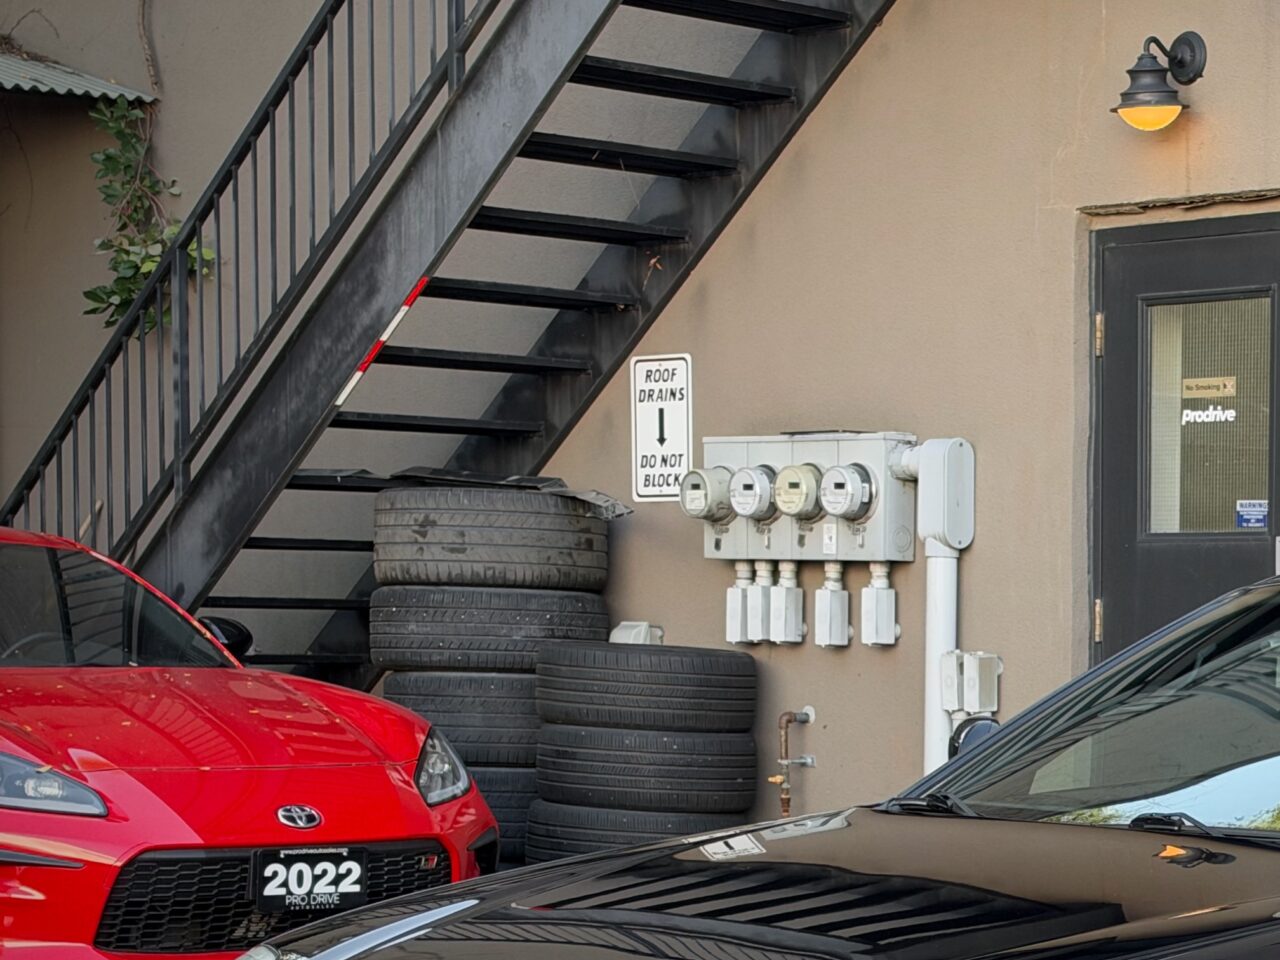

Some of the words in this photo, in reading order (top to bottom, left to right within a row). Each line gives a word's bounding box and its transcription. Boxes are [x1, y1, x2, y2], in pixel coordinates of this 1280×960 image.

[645, 368, 677, 383] ROOF
[638, 387, 685, 403] DRAINS
[1181, 405, 1237, 426] prodrive
[640, 455, 657, 469] DO
[660, 454, 684, 468] NOT
[643, 473, 681, 488] BLOCK
[263, 861, 361, 895] 2022
[285, 894, 308, 906] PRO
[310, 892, 340, 904] DRIVE
